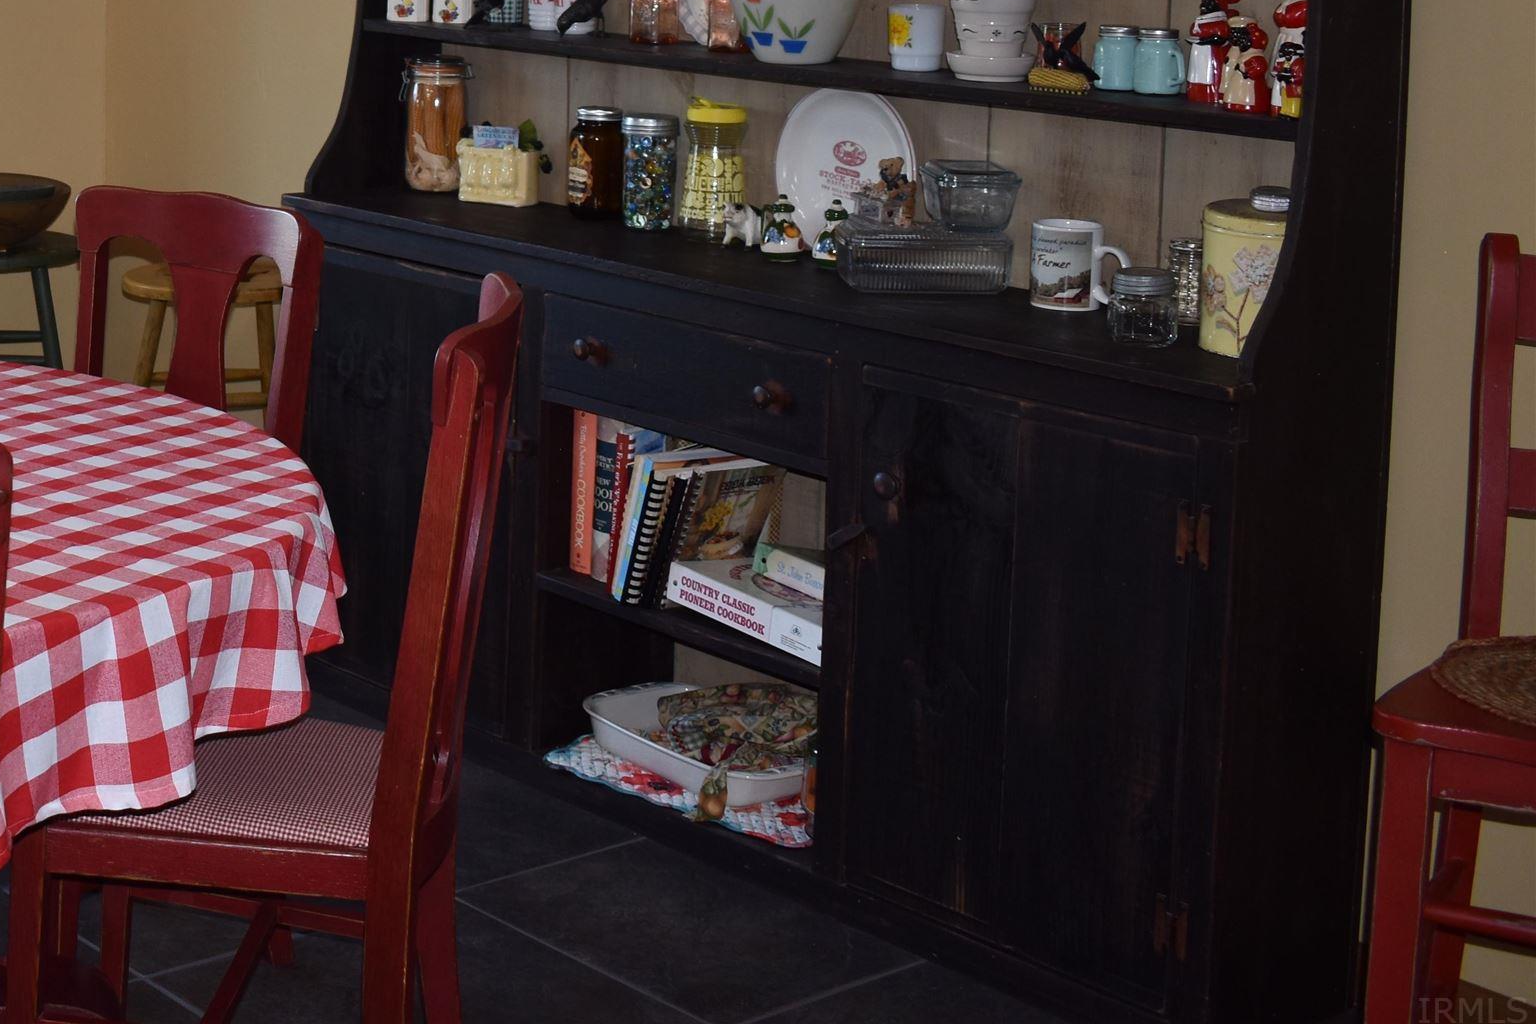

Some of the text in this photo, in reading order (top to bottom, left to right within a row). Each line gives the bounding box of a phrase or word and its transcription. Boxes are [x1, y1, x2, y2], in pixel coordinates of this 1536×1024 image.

[1037, 253, 1072, 269] Farmer
[575, 478, 586, 549] COOKBOOK
[679, 588, 766, 636] PIONEER COOKBOOK
[681, 575, 756, 616] COUNTRY CLASSIC
